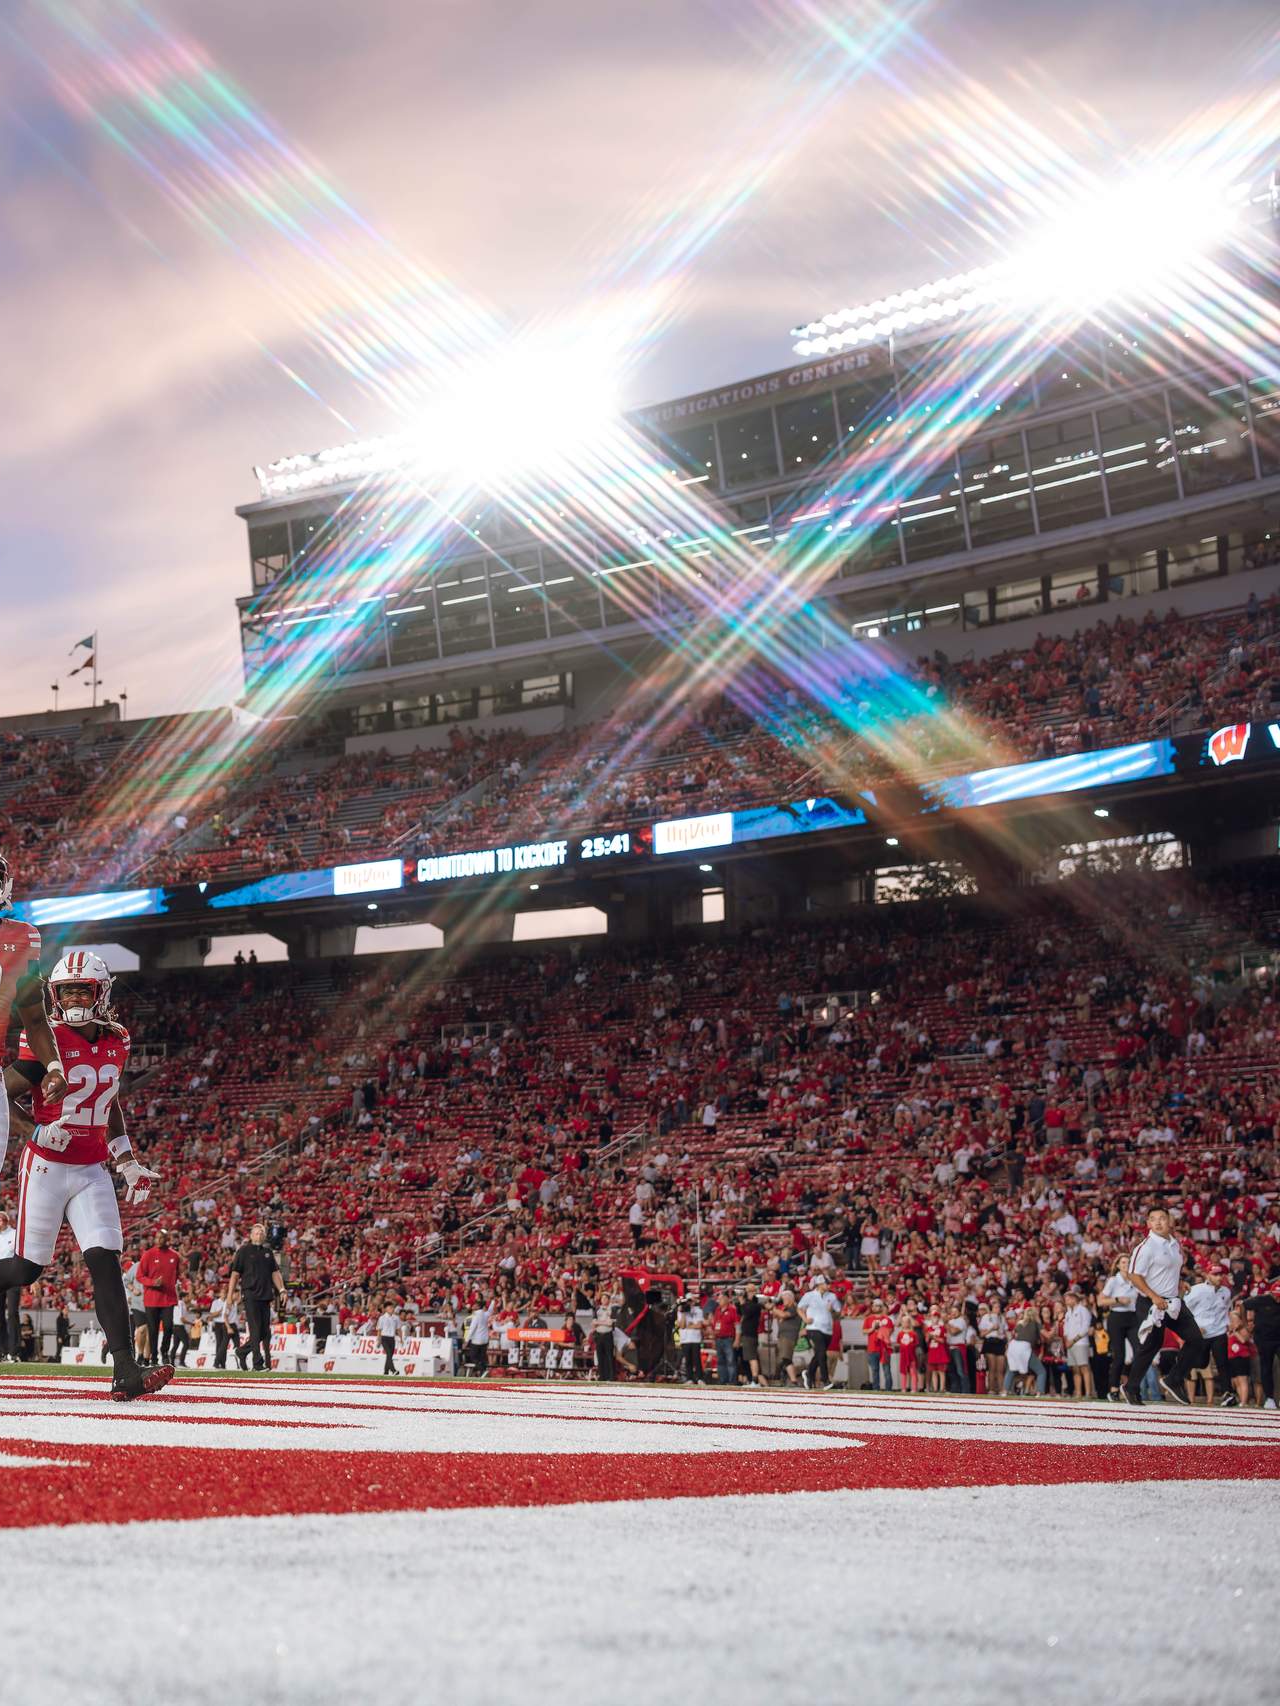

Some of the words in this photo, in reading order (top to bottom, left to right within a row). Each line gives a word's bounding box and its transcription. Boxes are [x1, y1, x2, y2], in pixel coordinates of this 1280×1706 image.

[788, 352, 872, 386] CENTER
[417, 850, 495, 882] COUNTDOWN
[496, 847, 513, 872] TO
[514, 840, 568, 870] KICKOFF
[581, 833, 631, 859] 25:41
[61, 1063, 119, 1127] 22
